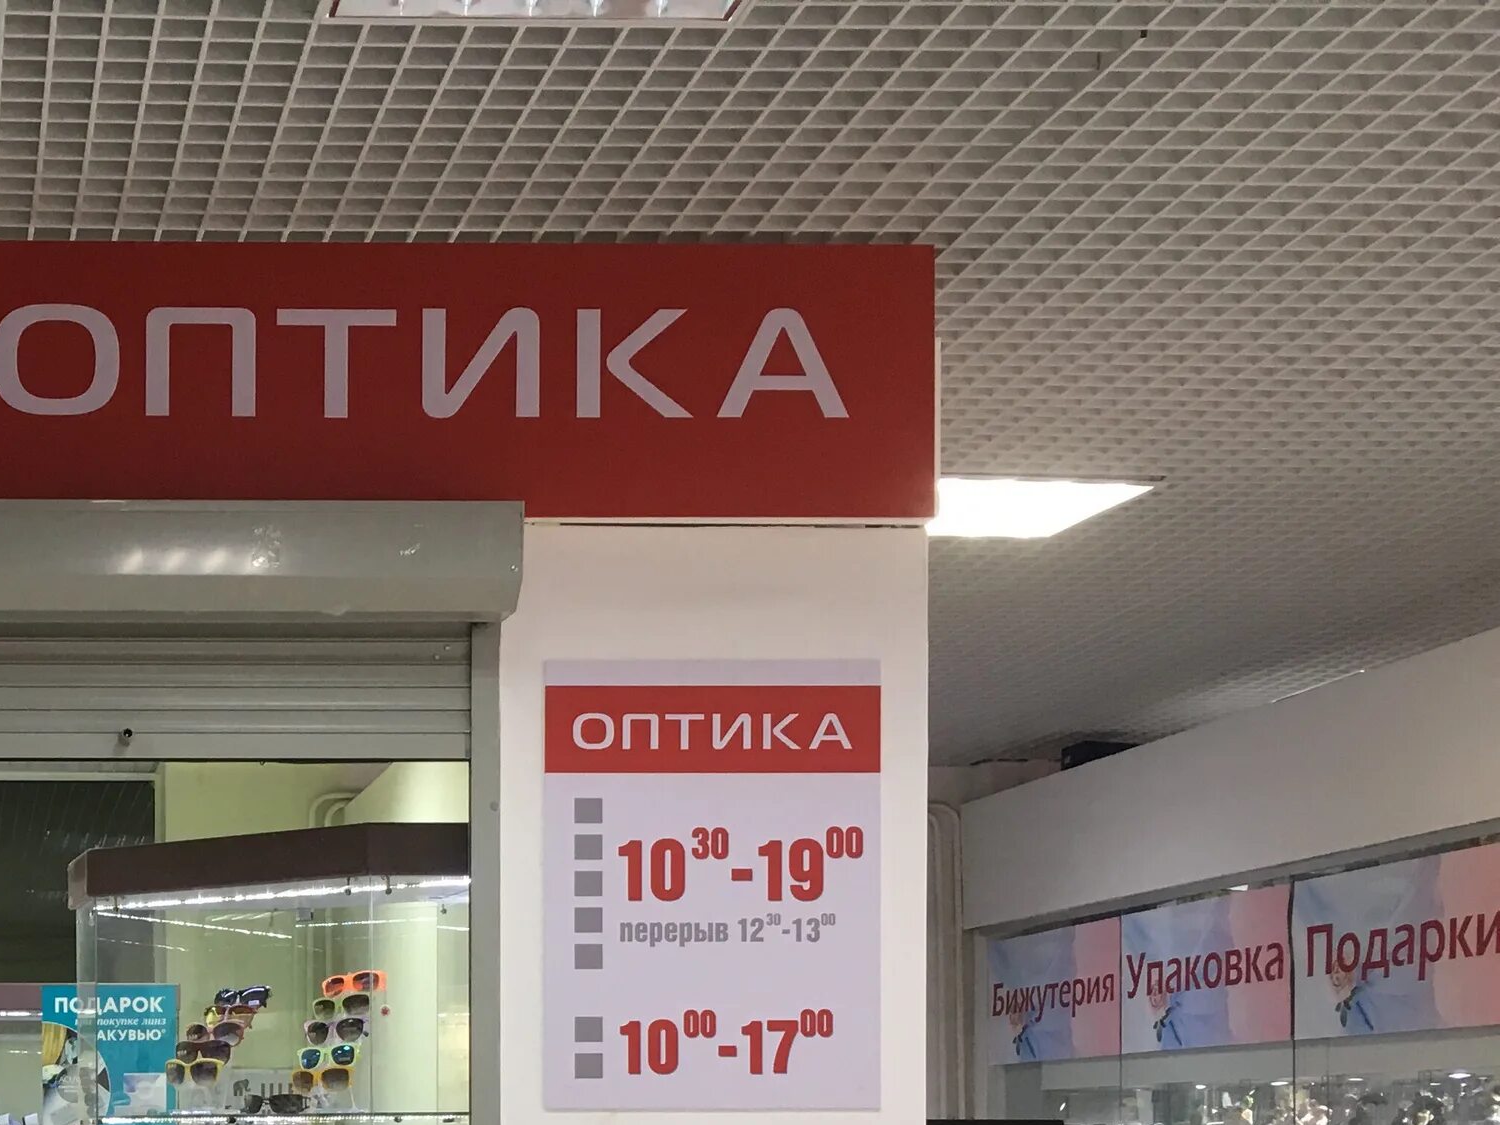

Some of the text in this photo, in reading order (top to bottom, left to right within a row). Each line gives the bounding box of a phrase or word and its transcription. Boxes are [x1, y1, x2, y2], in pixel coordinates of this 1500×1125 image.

[572, 712, 853, 750] ОПТИКА
[619, 919, 730, 947] перерыв
[1305, 909, 1500, 982] Подарки
[1126, 942, 1286, 1000] Упаковка
[54, 996, 163, 1016] ПОДАРОК
[991, 972, 1116, 1022] Бижутерия
